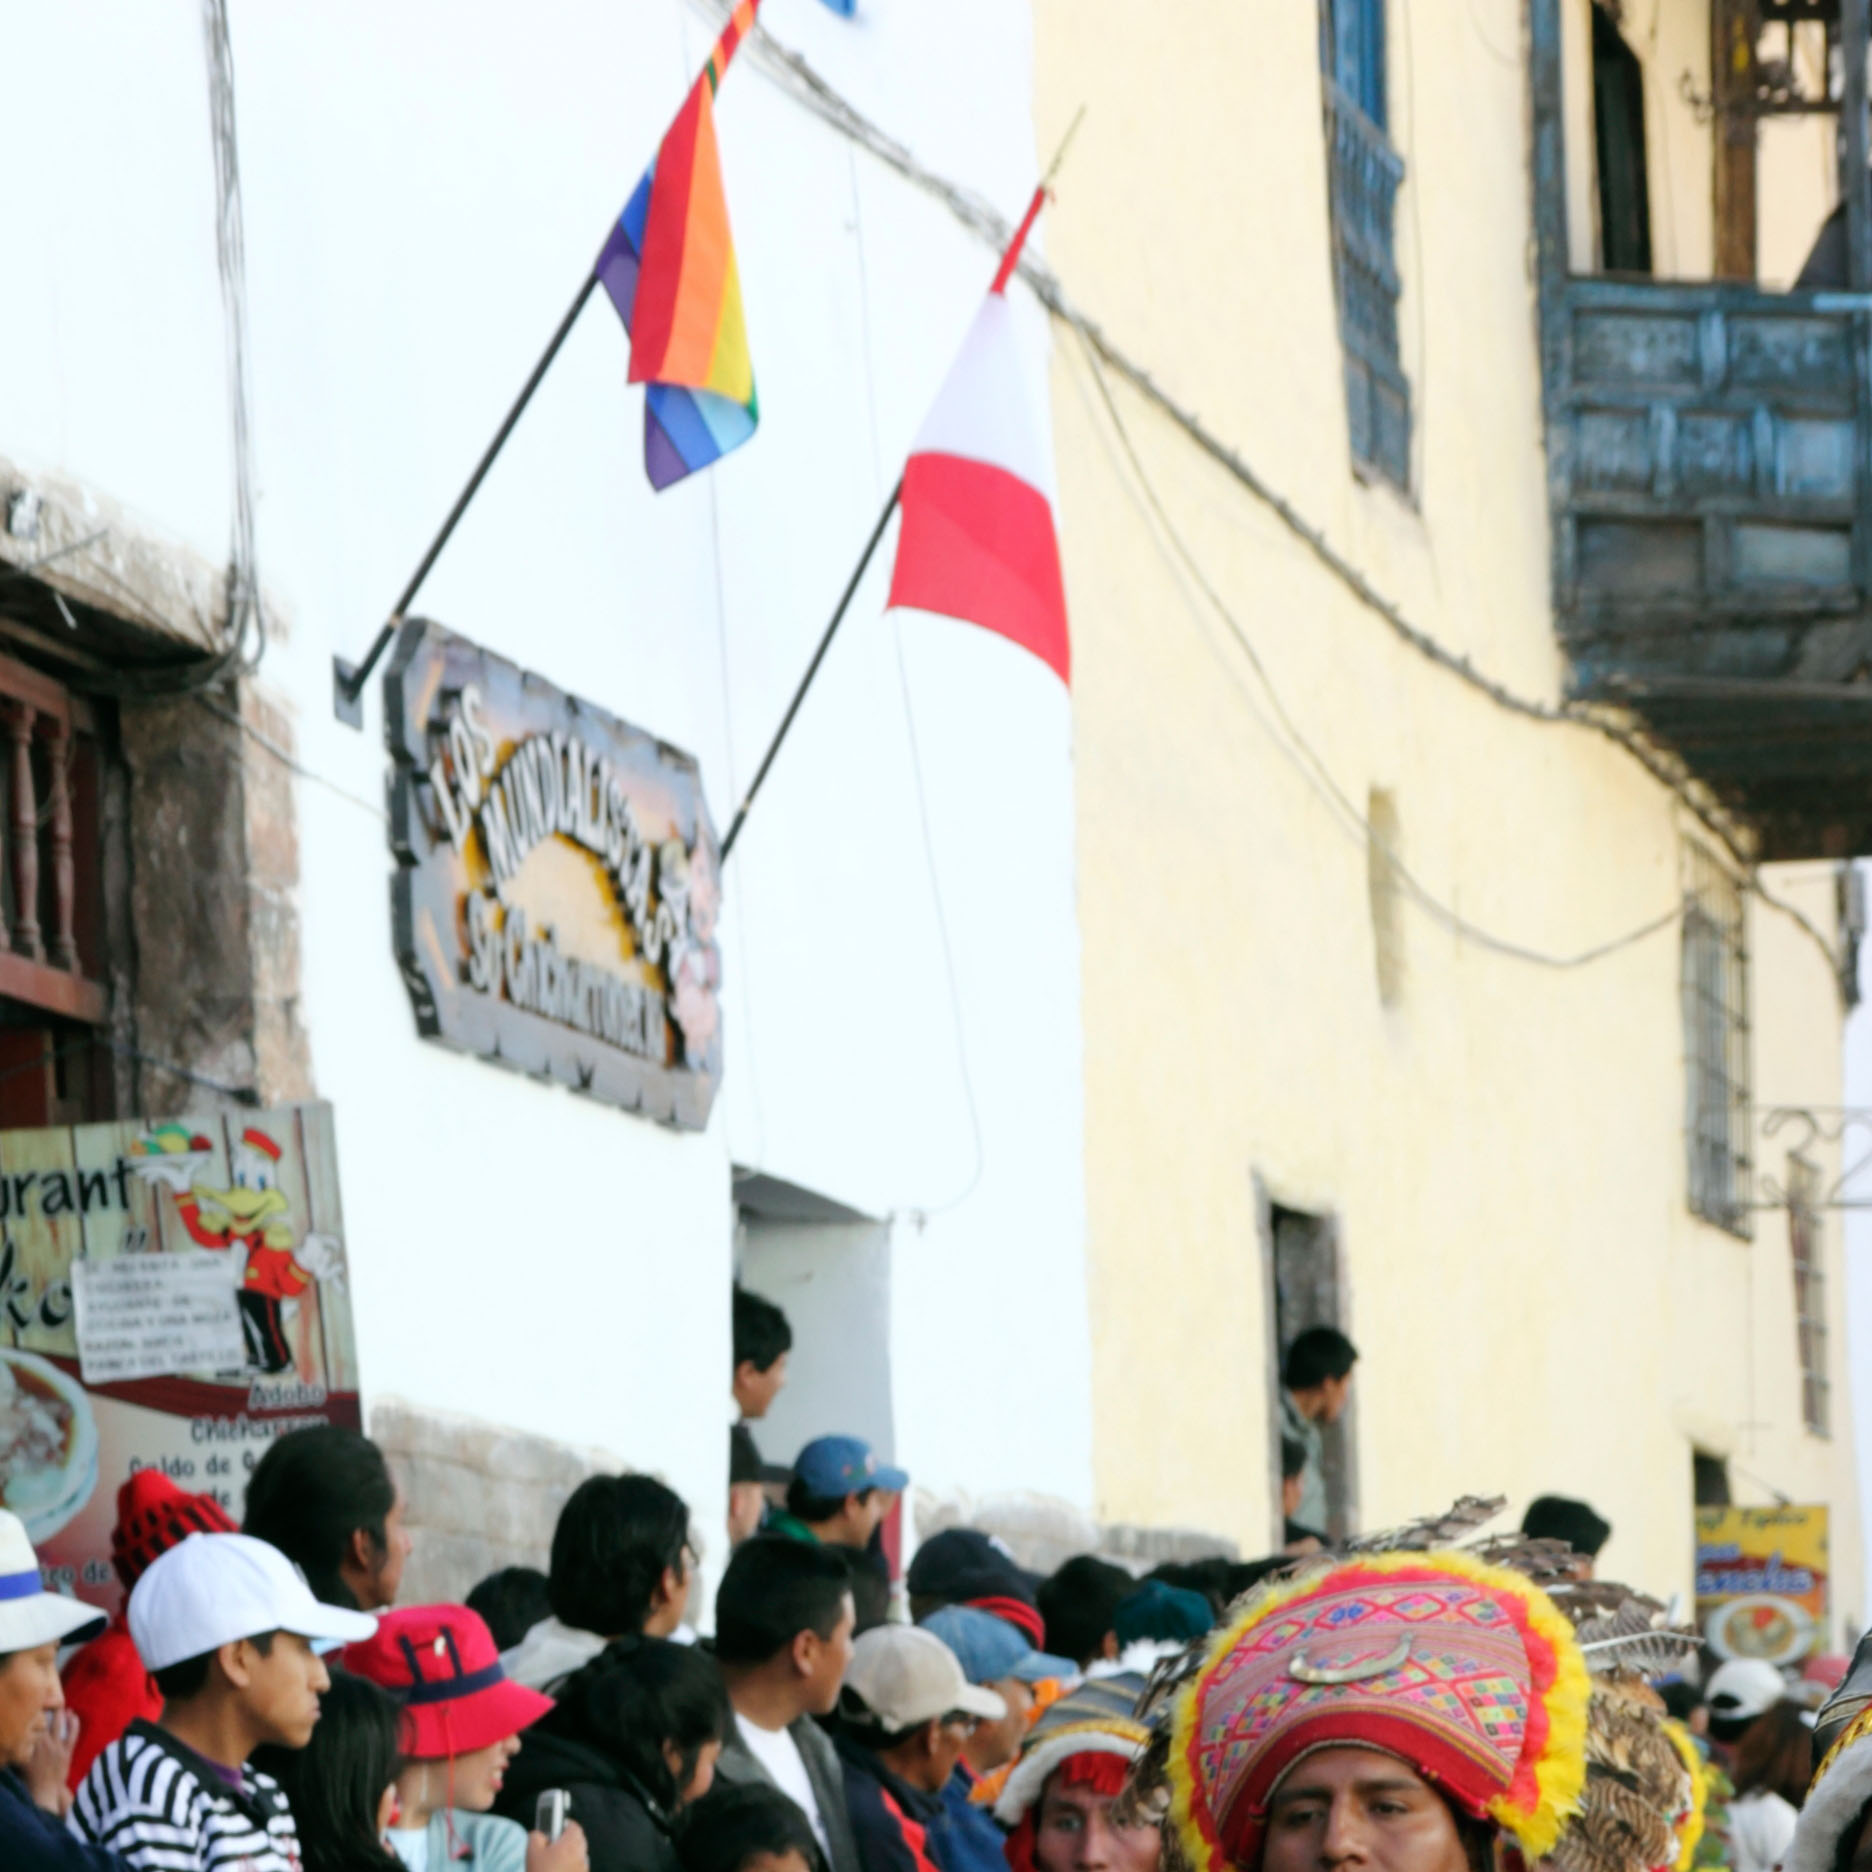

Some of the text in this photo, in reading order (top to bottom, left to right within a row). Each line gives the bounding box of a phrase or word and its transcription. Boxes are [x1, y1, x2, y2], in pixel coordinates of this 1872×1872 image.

[431, 684, 496, 853] LOS
[481, 728, 674, 964] MUNDIALISTAS
[248, 1381, 326, 1409] Adobo
[129, 1454, 196, 1477] Cldo
[205, 1452, 231, 1475] de
